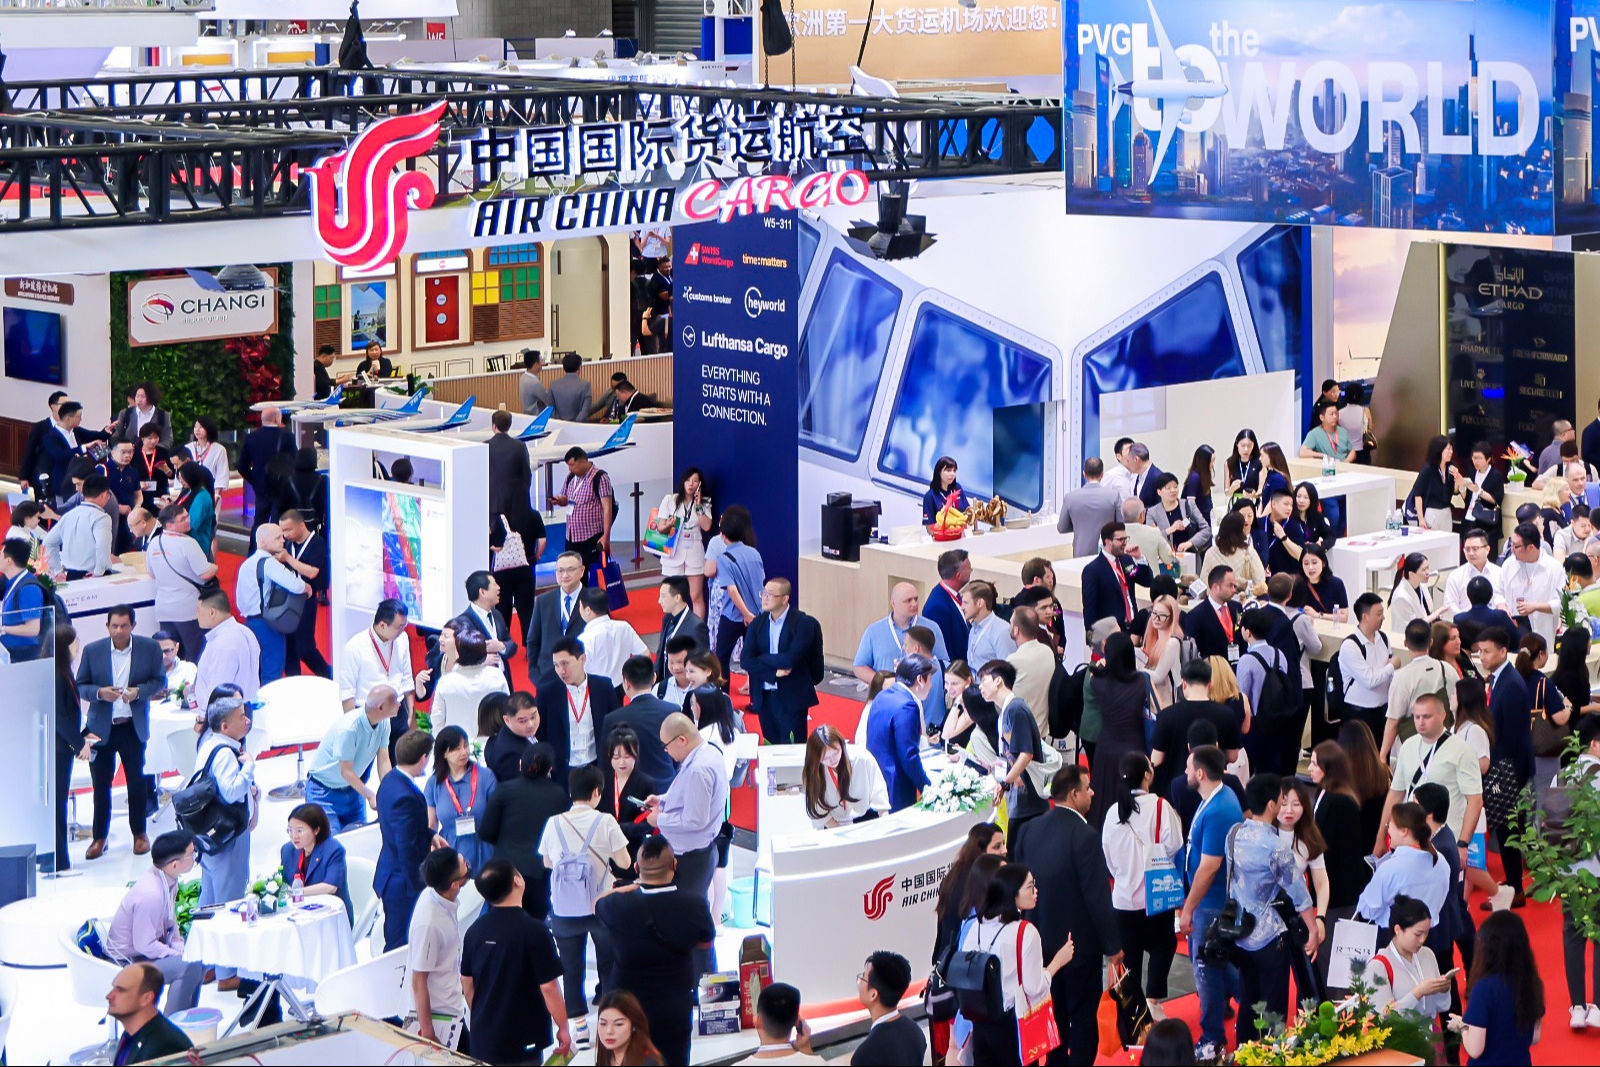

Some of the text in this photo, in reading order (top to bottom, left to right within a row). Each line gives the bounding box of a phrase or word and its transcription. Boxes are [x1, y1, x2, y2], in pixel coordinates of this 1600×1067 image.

[1077, 23, 1132, 55] PVG
[1209, 20, 1260, 57] the
[1221, 60, 1540, 156] WORLD
[468, 110, 868, 181] 中国国际货运航空
[471, 169, 869, 237] AIR CHINA CARGO
[763, 217, 792, 230] W5-311
[701, 245, 720, 255] SWISS
[742, 254, 788, 268] time:matters
[689, 292, 732, 304] customs broker
[1478, 283, 1543, 300] ETIHAD
[180, 294, 265, 314] CHANGI
[748, 295, 786, 314] heyworld
[1495, 300, 1525, 311] CARGO
[701, 330, 788, 361] Lufthansa Cargo
[701, 364, 761, 385] EVERYTHING
[702, 383, 771, 406] STARTS WITH A
[702, 403, 767, 426] CONNECTION.
[65, 594, 98, 604] KYTEAM
[902, 887, 941, 907] AIR CHIN
